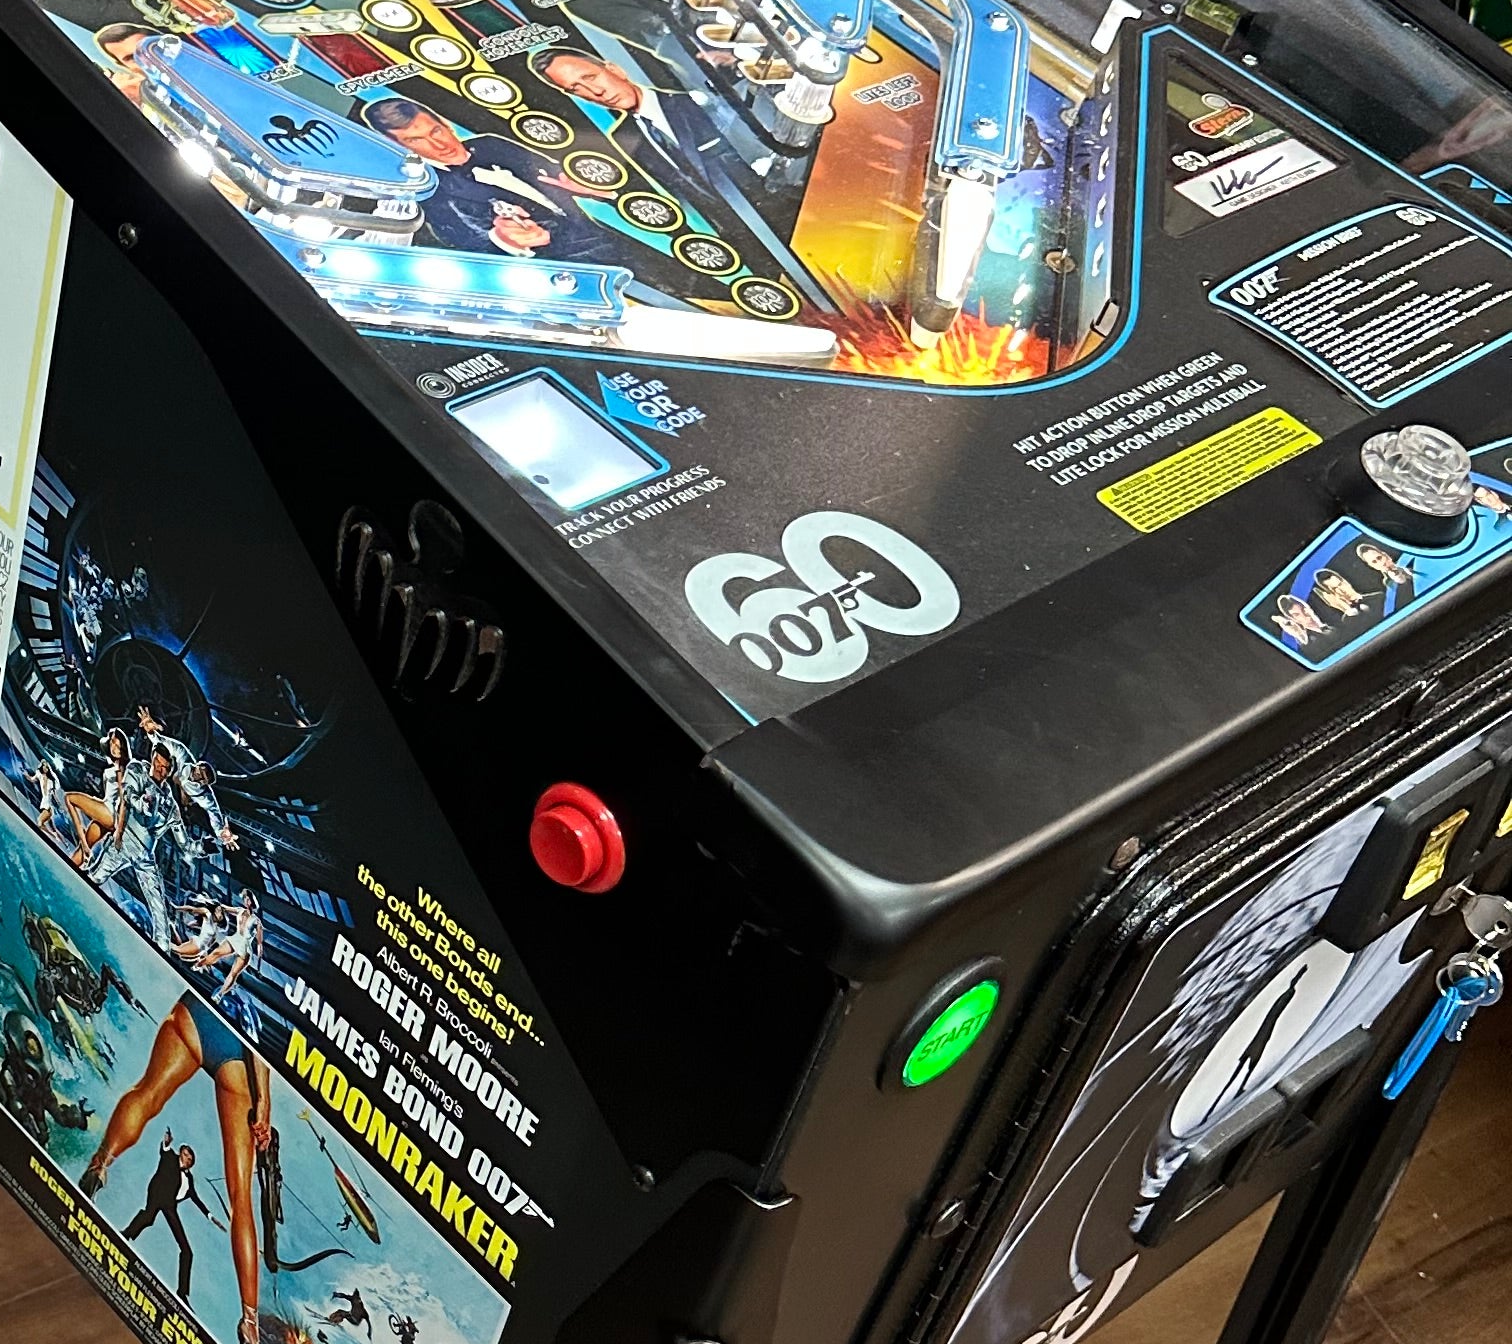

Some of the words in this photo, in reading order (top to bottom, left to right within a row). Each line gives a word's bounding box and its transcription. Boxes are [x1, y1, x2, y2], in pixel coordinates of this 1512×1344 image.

[370, 64, 423, 86] CAMERA
[444, 354, 504, 383] INSIDER
[604, 372, 639, 392] USE
[619, 379, 670, 404] YOUR
[637, 395, 680, 418] QR
[656, 406, 707, 433] CODE
[1013, 436, 1042, 455] HIT
[1039, 413, 1096, 444] ACTION
[1086, 388, 1145, 421] BUTTON
[1141, 371, 1183, 395] WHEN
[1178, 352, 1223, 377] GREEN
[1026, 453, 1054, 472] TO
[1052, 436, 1091, 464] DROP
[1085, 417, 1133, 445] INLINE
[1128, 401, 1167, 426] DROP
[1165, 373, 1222, 407] TARGETS
[1219, 364, 1248, 385] AND
[1050, 463, 1087, 486] LITE
[1080, 442, 1125, 474] LOCK
[1117, 434, 1153, 458] FOR
[1148, 408, 1205, 441] MISSION
[1197, 379, 1266, 417] MULTIBALL
[554, 508, 606, 536] TRACK
[600, 494, 644, 516] YOUR
[637, 464, 710, 501] PROGRESS
[568, 515, 636, 550] CONNECT
[630, 502, 672, 523] WITH
[667, 476, 727, 508] FRIENDS
[684, 510, 961, 682] 60
[358, 864, 386, 899] the
[387, 894, 435, 942] other
[436, 933, 494, 997] Bonds
[495, 994, 545, 1046] end...
[377, 910, 408, 948] this
[410, 944, 444, 981] one
[445, 971, 515, 1045] begins!
[418, 887, 476, 951] Where
[477, 947, 501, 974] all
[331, 934, 427, 1042] ROGER
[427, 1024, 540, 1148] MOORE
[377, 946, 418, 991] Albert
[420, 984, 433, 1007] R.
[436, 997, 493, 1058] Broccoli
[379, 1029, 401, 1062] Ian
[918, 1010, 988, 1062] START
[285, 976, 379, 1079] JAMES
[383, 1059, 465, 1160] BOND
[468, 1148, 536, 1216] 007
[285, 1029, 521, 1280] MOONRAKER
[30, 1156, 75, 1212] ROGER
[77, 1206, 129, 1270] MOORE
[67, 1214, 103, 1262] FOR
[108, 1260, 157, 1322] YOUR
